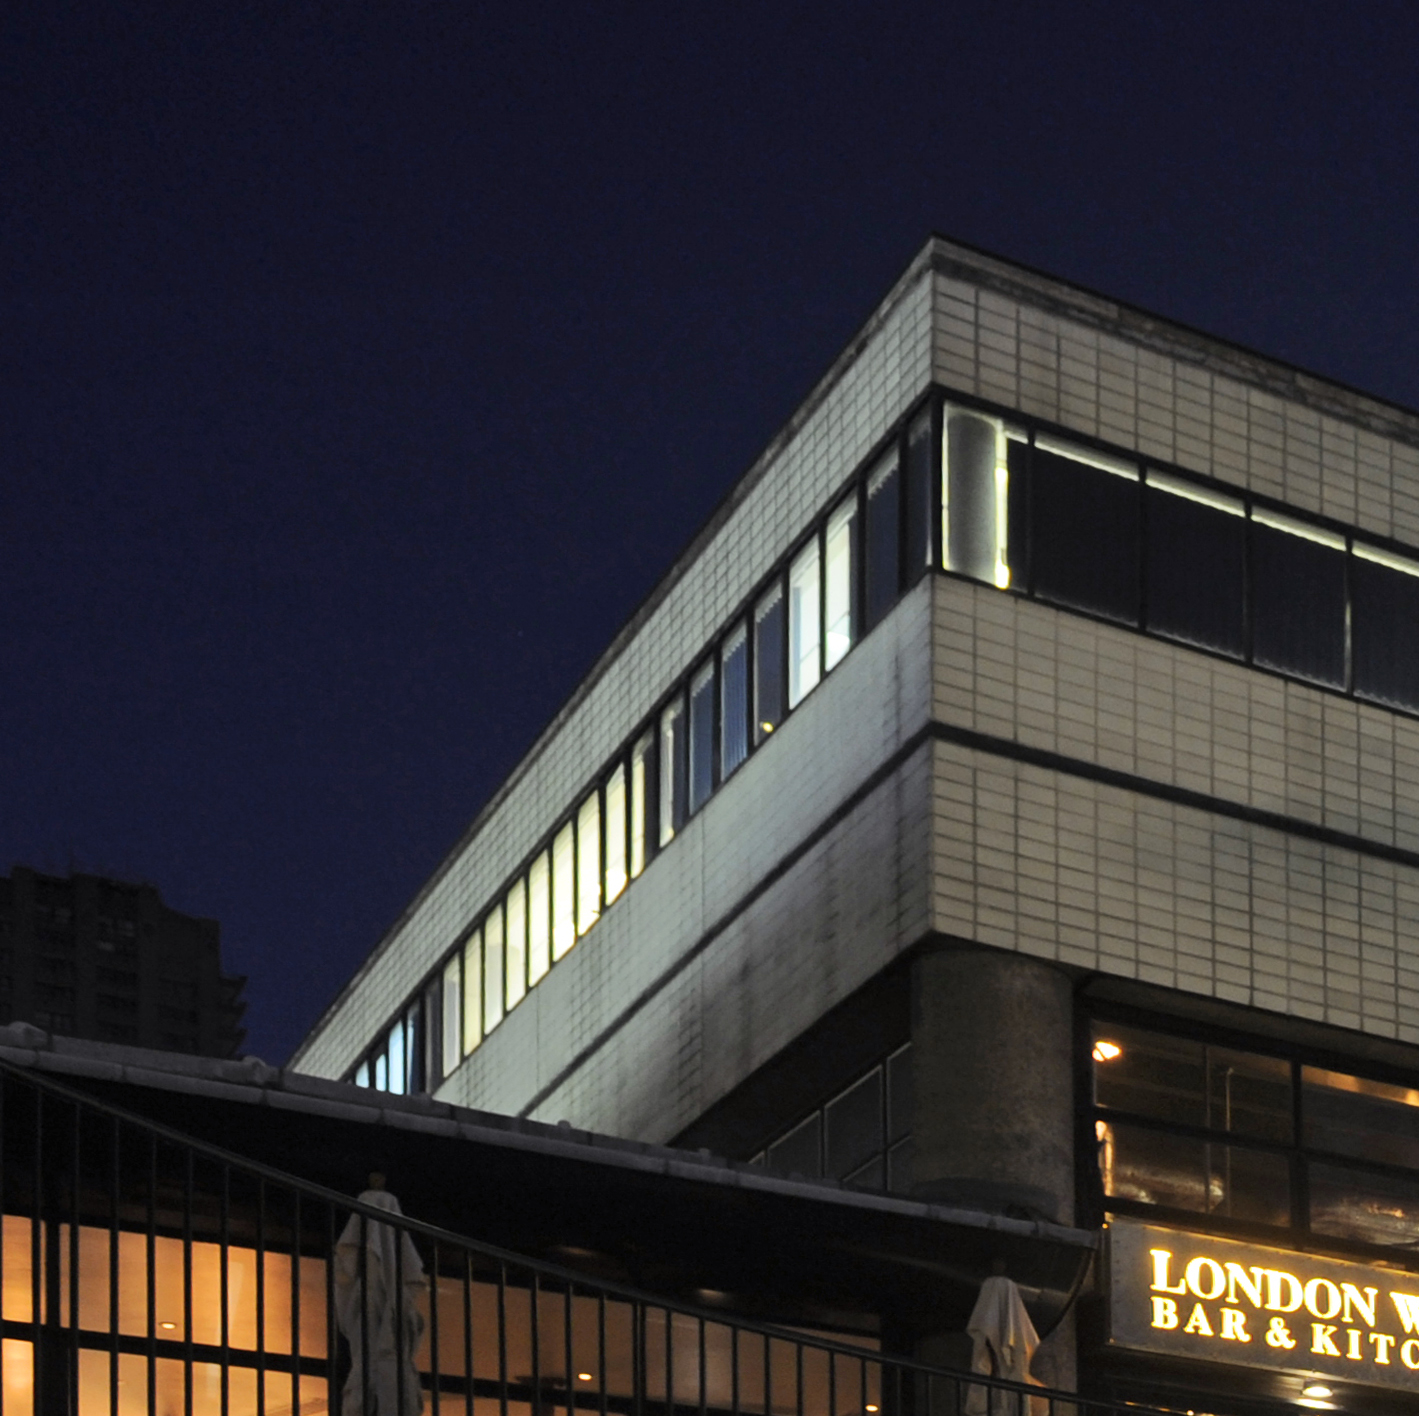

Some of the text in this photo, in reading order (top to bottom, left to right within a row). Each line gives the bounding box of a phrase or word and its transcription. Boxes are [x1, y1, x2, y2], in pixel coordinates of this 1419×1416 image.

[1149, 1248, 1379, 1328] LONDON
[1150, 1296, 1252, 1343] BAR
[1265, 1316, 1297, 1349] &
